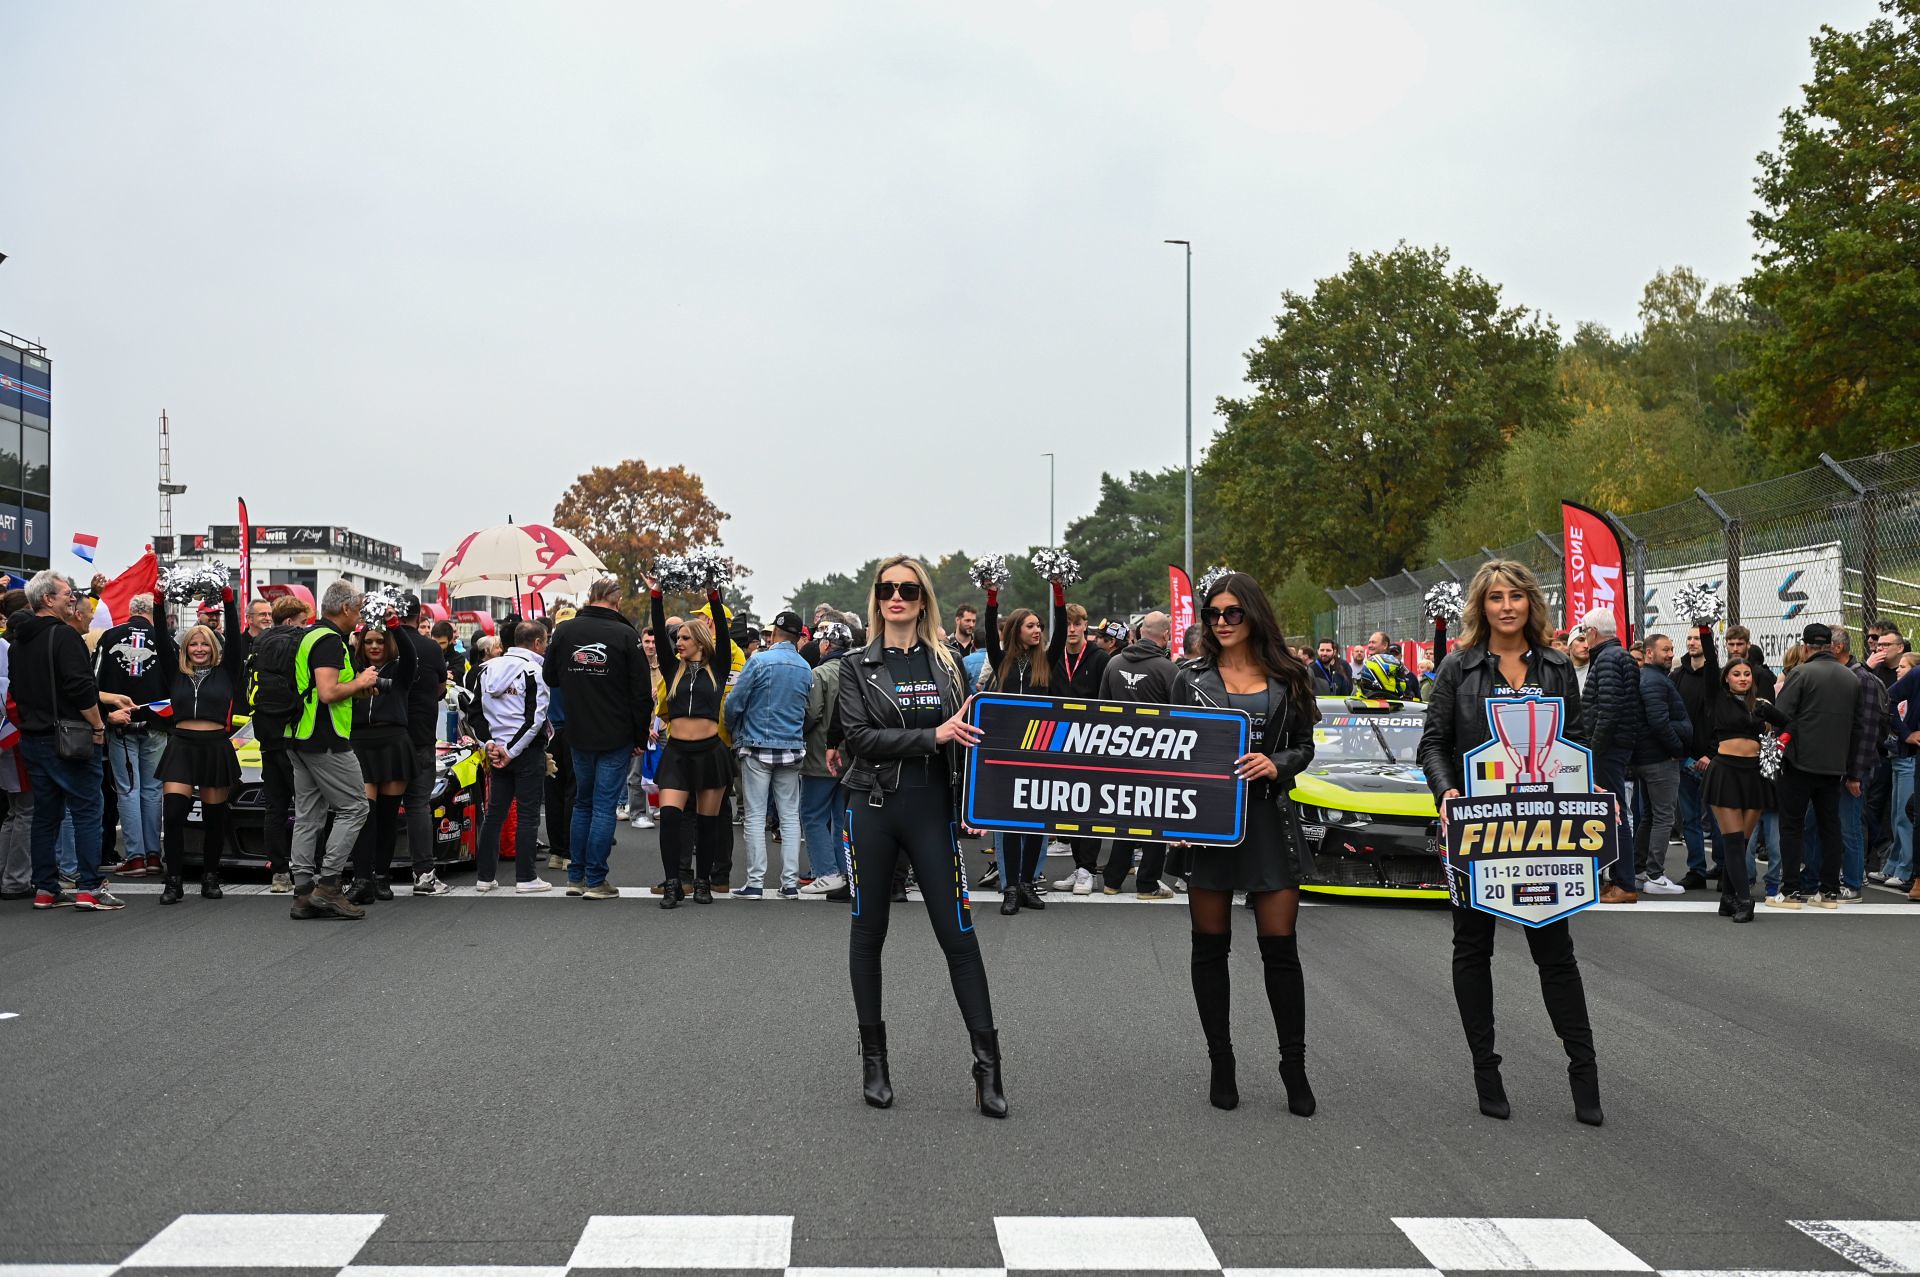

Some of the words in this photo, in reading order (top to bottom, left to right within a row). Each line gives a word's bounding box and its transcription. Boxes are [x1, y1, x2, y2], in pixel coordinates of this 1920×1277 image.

[1498, 687, 1544, 696] NASCA
[1356, 718, 1423, 727] NASCAR
[1063, 722, 1198, 761] NASCAR
[1519, 785, 1549, 793] NASCAR
[1013, 778, 1091, 813] EURO
[1099, 784, 1197, 820] SERIES
[1452, 804, 1512, 821] NASCAR
[1517, 802, 1554, 816] EURO
[1559, 801, 1608, 816] SERIES
[1459, 819, 1606, 856] FINALS
[844, 847, 855, 897] NASCAR
[1484, 866, 1520, 878] 11-12
[1526, 864, 1584, 877] OCTOBER
[1485, 884, 1505, 900] 20
[1565, 882, 1585, 897] 25
[1532, 895, 1552, 903] SERIES
